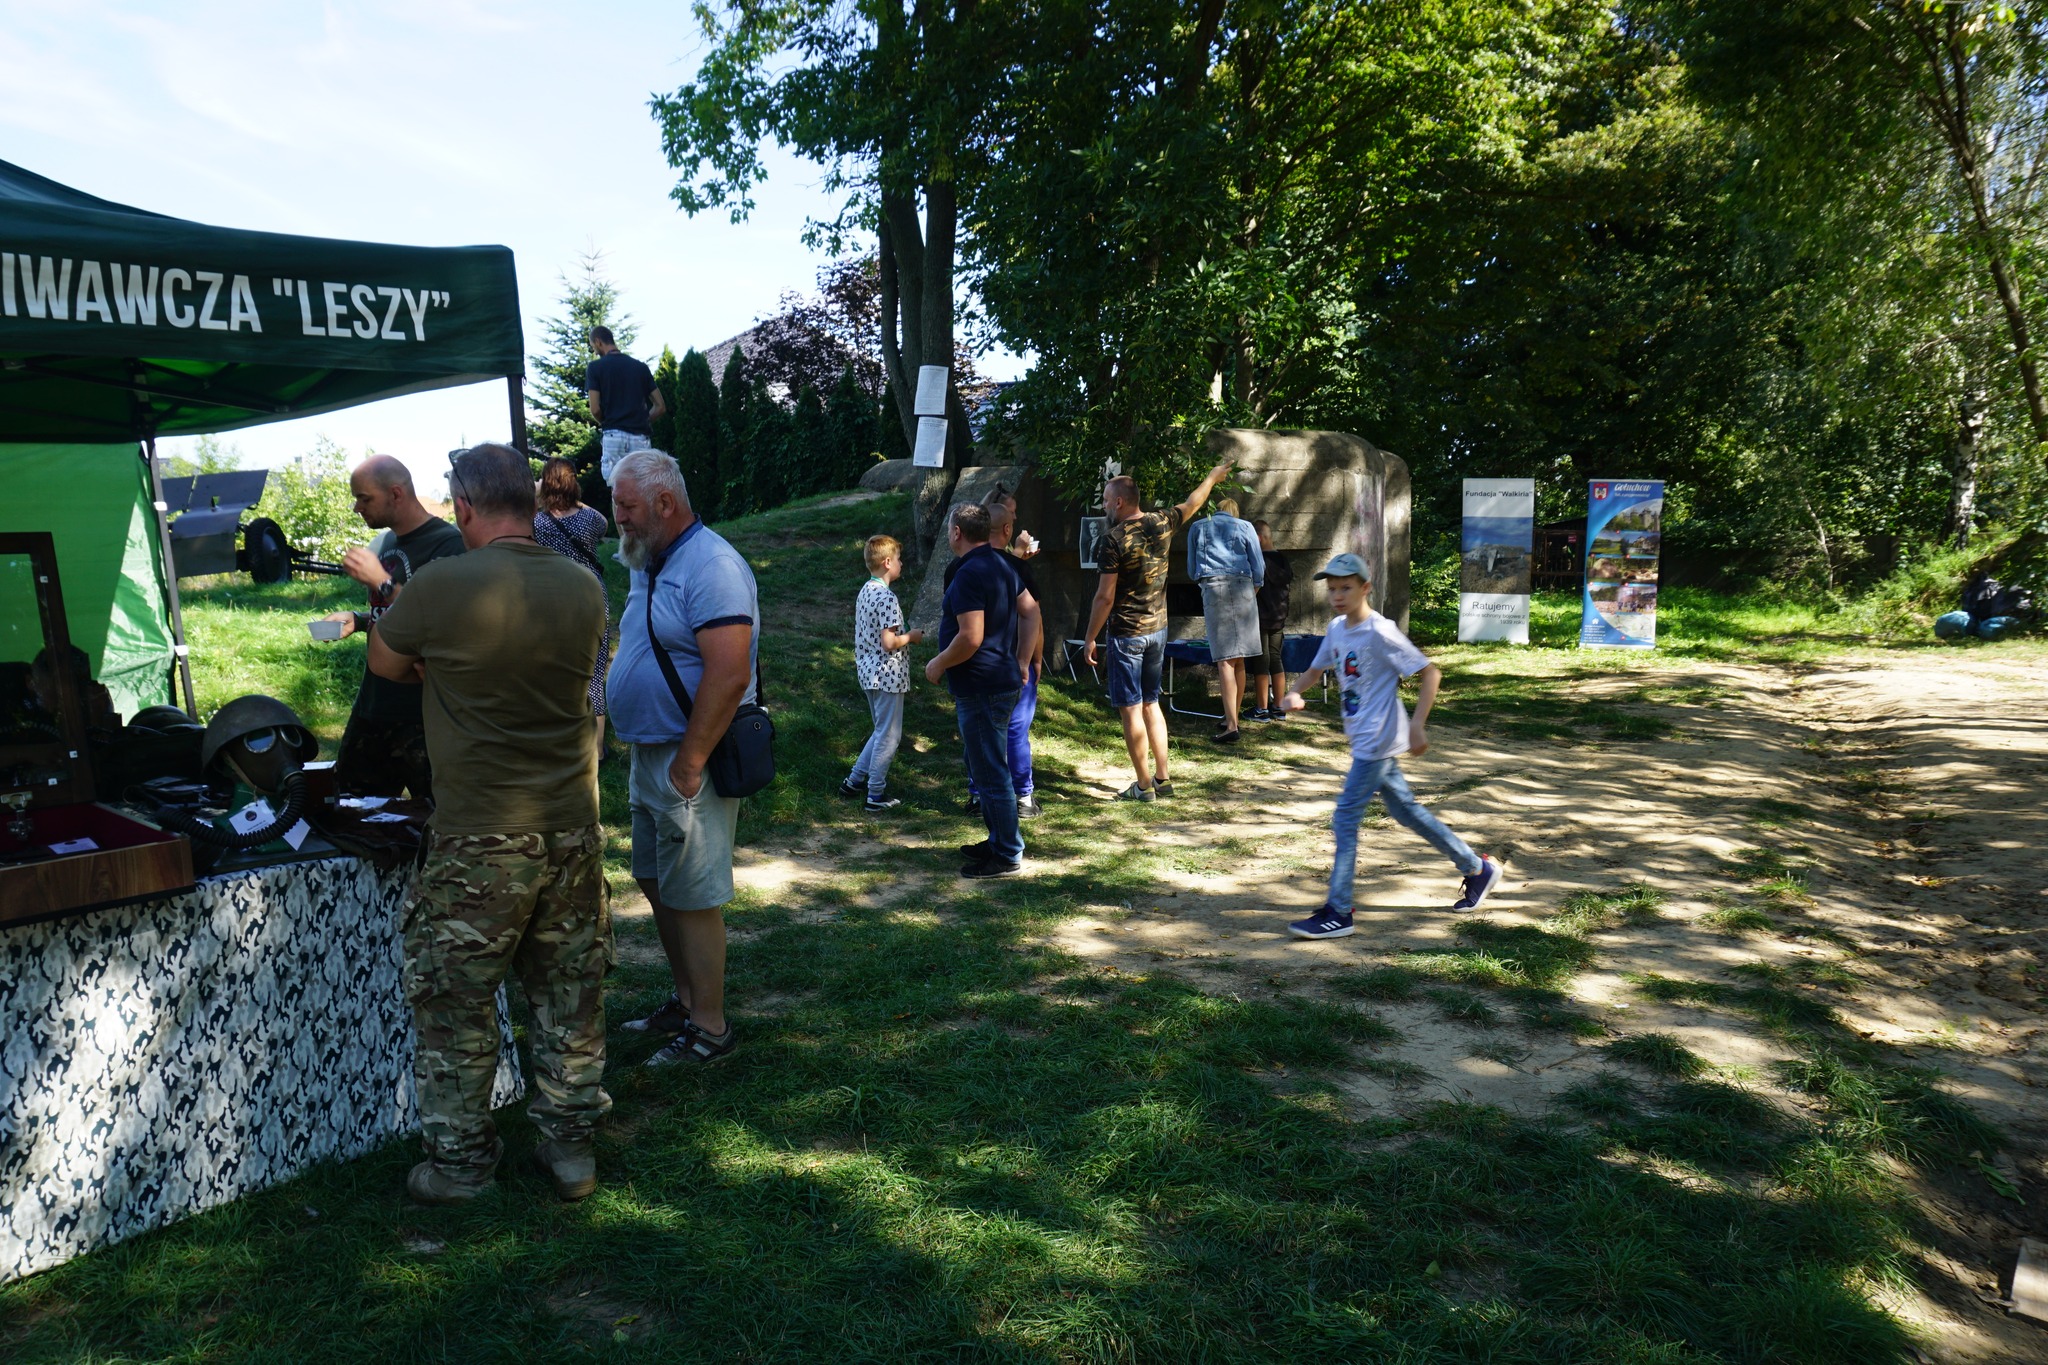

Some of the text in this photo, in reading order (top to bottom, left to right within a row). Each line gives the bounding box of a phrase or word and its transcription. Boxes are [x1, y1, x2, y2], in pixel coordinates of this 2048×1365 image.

[0, 252, 263, 333] IWAWCZA
[1465, 490, 1497, 498] Fundacja
[1472, 601, 1516, 612] Ratujemy
